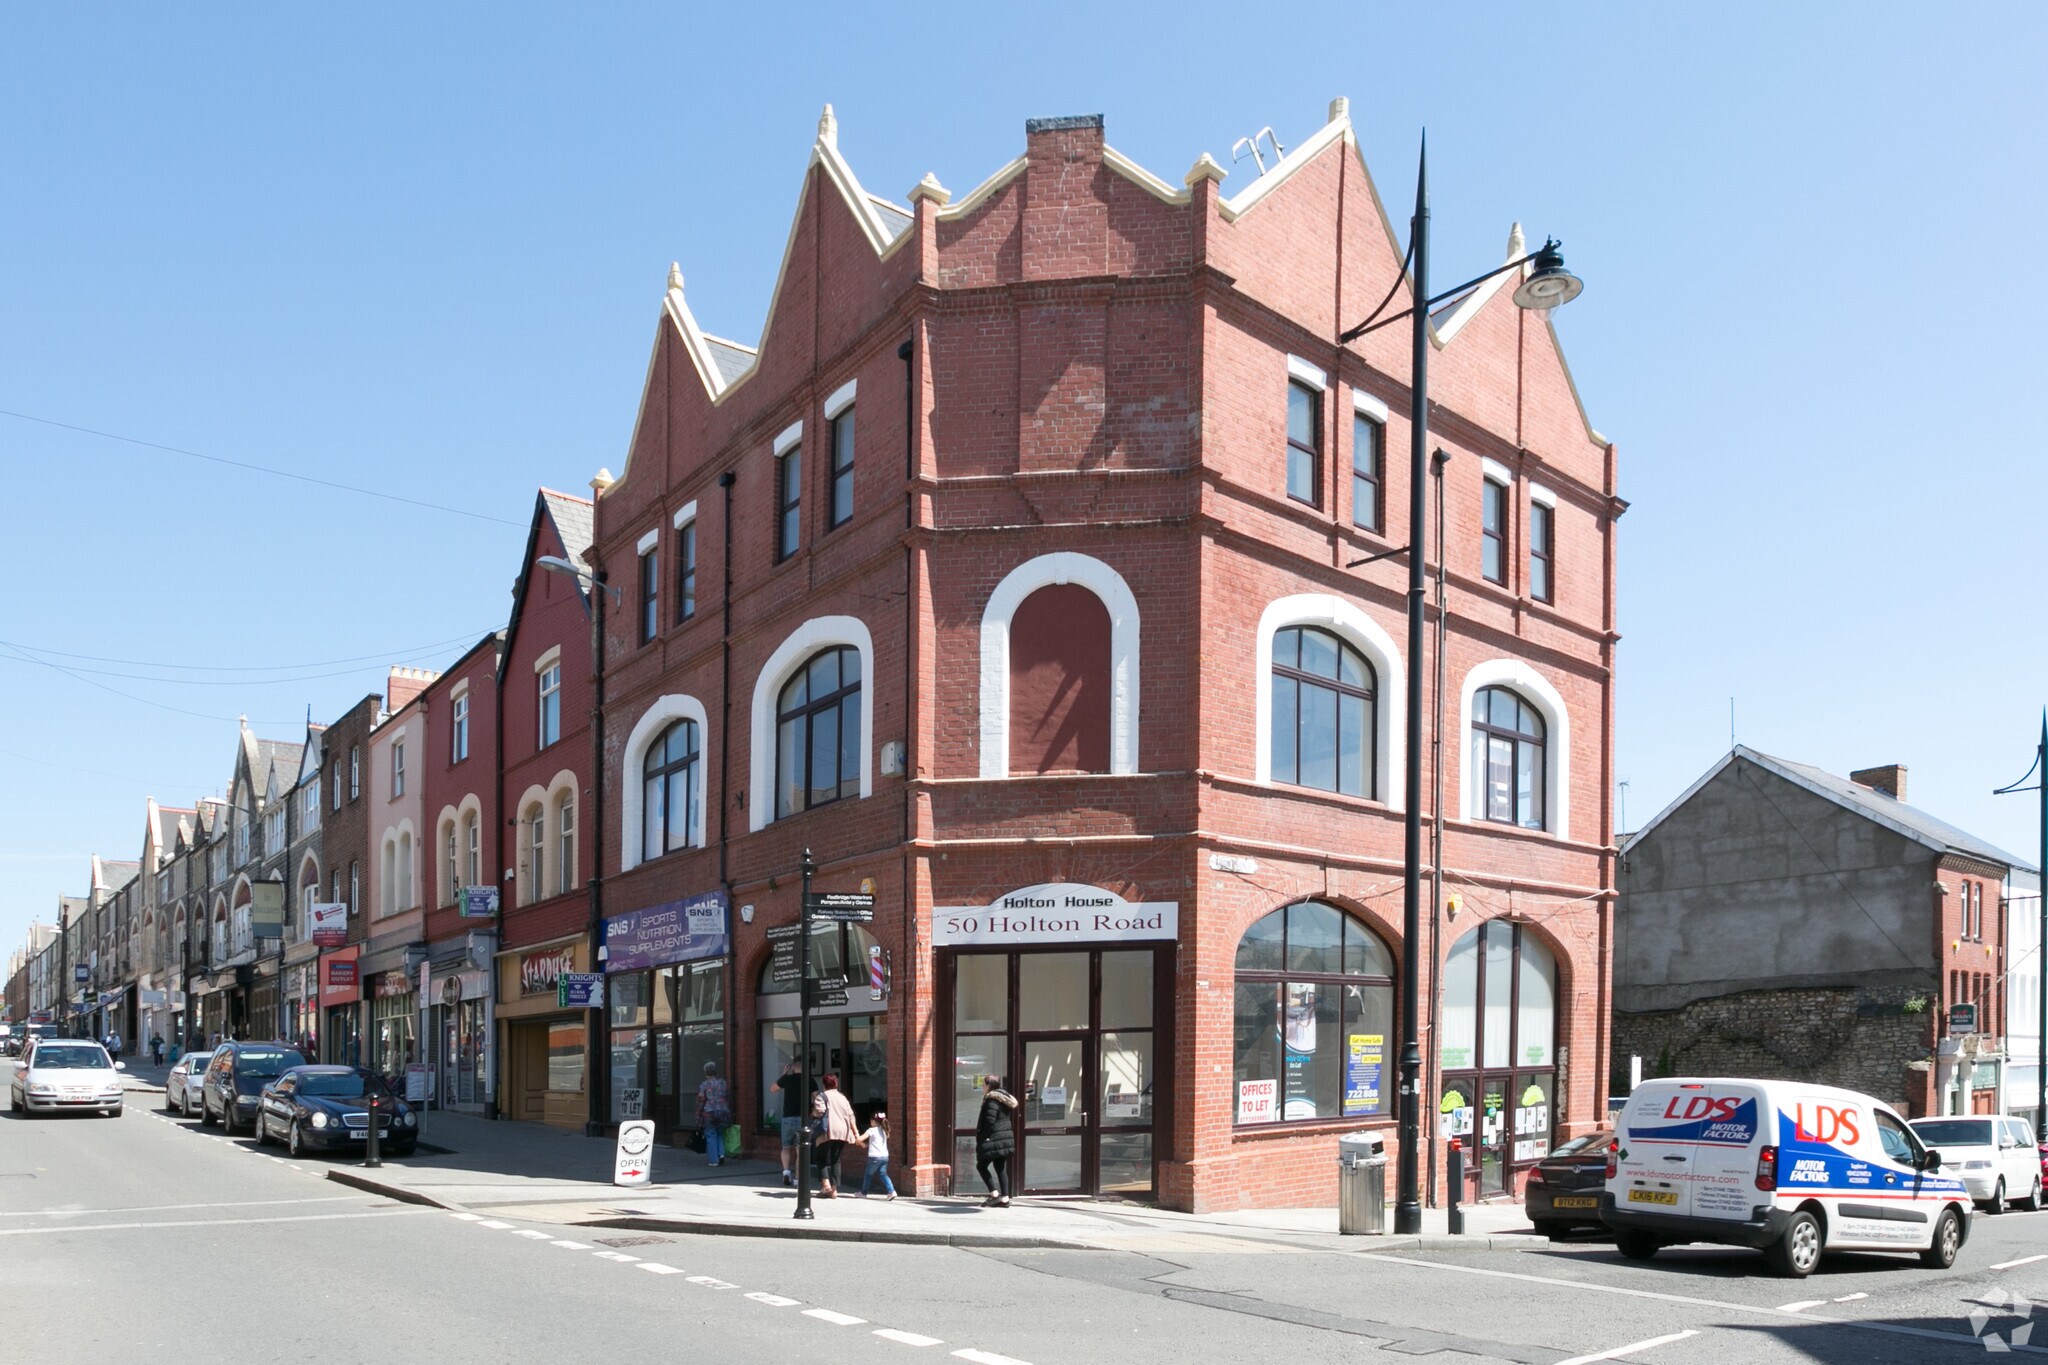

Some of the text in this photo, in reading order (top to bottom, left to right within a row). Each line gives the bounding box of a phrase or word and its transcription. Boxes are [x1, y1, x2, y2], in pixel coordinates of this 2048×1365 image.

[1004, 896, 1113, 908] Holton House
[642, 911, 677, 928] SPORTS
[946, 913, 1163, 934] 50 Holton Road
[608, 920, 628, 936] SNS
[637, 923, 682, 940] NUTRITION
[629, 934, 692, 955] SUPPLEMENTS
[623, 1090, 640, 1101] SHOP
[1242, 1084, 1272, 1096] OFFICES
[1348, 1090, 1362, 1098] 722
[622, 1102, 641, 1114] TO LET
[1242, 1100, 1269, 1112] TO LET
[1663, 1096, 1742, 1122] LDS
[1710, 1123, 1747, 1132] MOTOR
[1795, 1103, 1860, 1145] LDS
[1702, 1130, 1750, 1140] FACTORS
[620, 1159, 647, 1167] OPEN
[1794, 1160, 1825, 1171] MOTOR
[1626, 1169, 1739, 1184] www.ldsmotorfactors.com
[1790, 1170, 1829, 1182] FACTORS
[1633, 1191, 1673, 1202] CK16 KPJ
